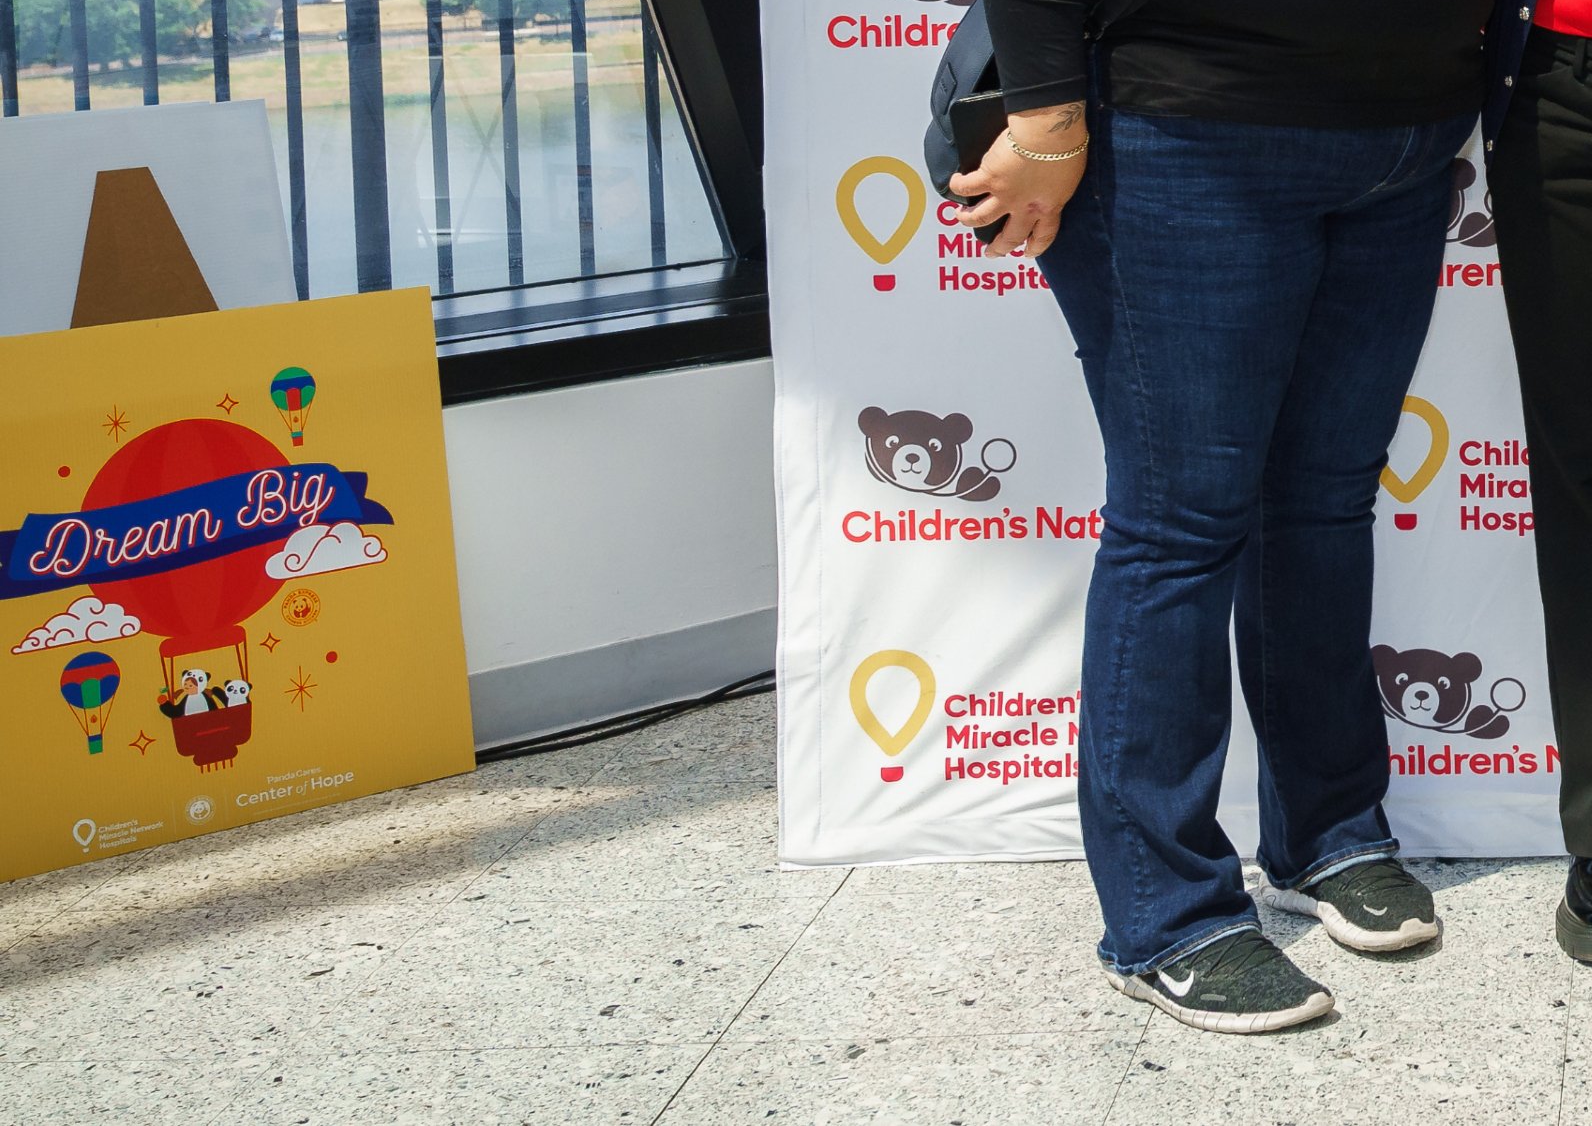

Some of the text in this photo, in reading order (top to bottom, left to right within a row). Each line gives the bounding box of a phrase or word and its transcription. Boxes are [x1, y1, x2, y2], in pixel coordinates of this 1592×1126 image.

[827, 13, 960, 49] Childr
[938, 263, 1050, 296] Hospit
[1459, 473, 1528, 499] Mira
[29, 469, 334, 576] Dream Big
[841, 507, 1029, 543] Children's
[943, 690, 1082, 719] Children'
[945, 721, 1059, 750] Miracle
[267, 766, 322, 784] Panda Cares
[1388, 745, 1539, 776] hildren's
[235, 785, 292, 807] Center
[295, 780, 309, 796] of
[310, 771, 354, 791] Hope
